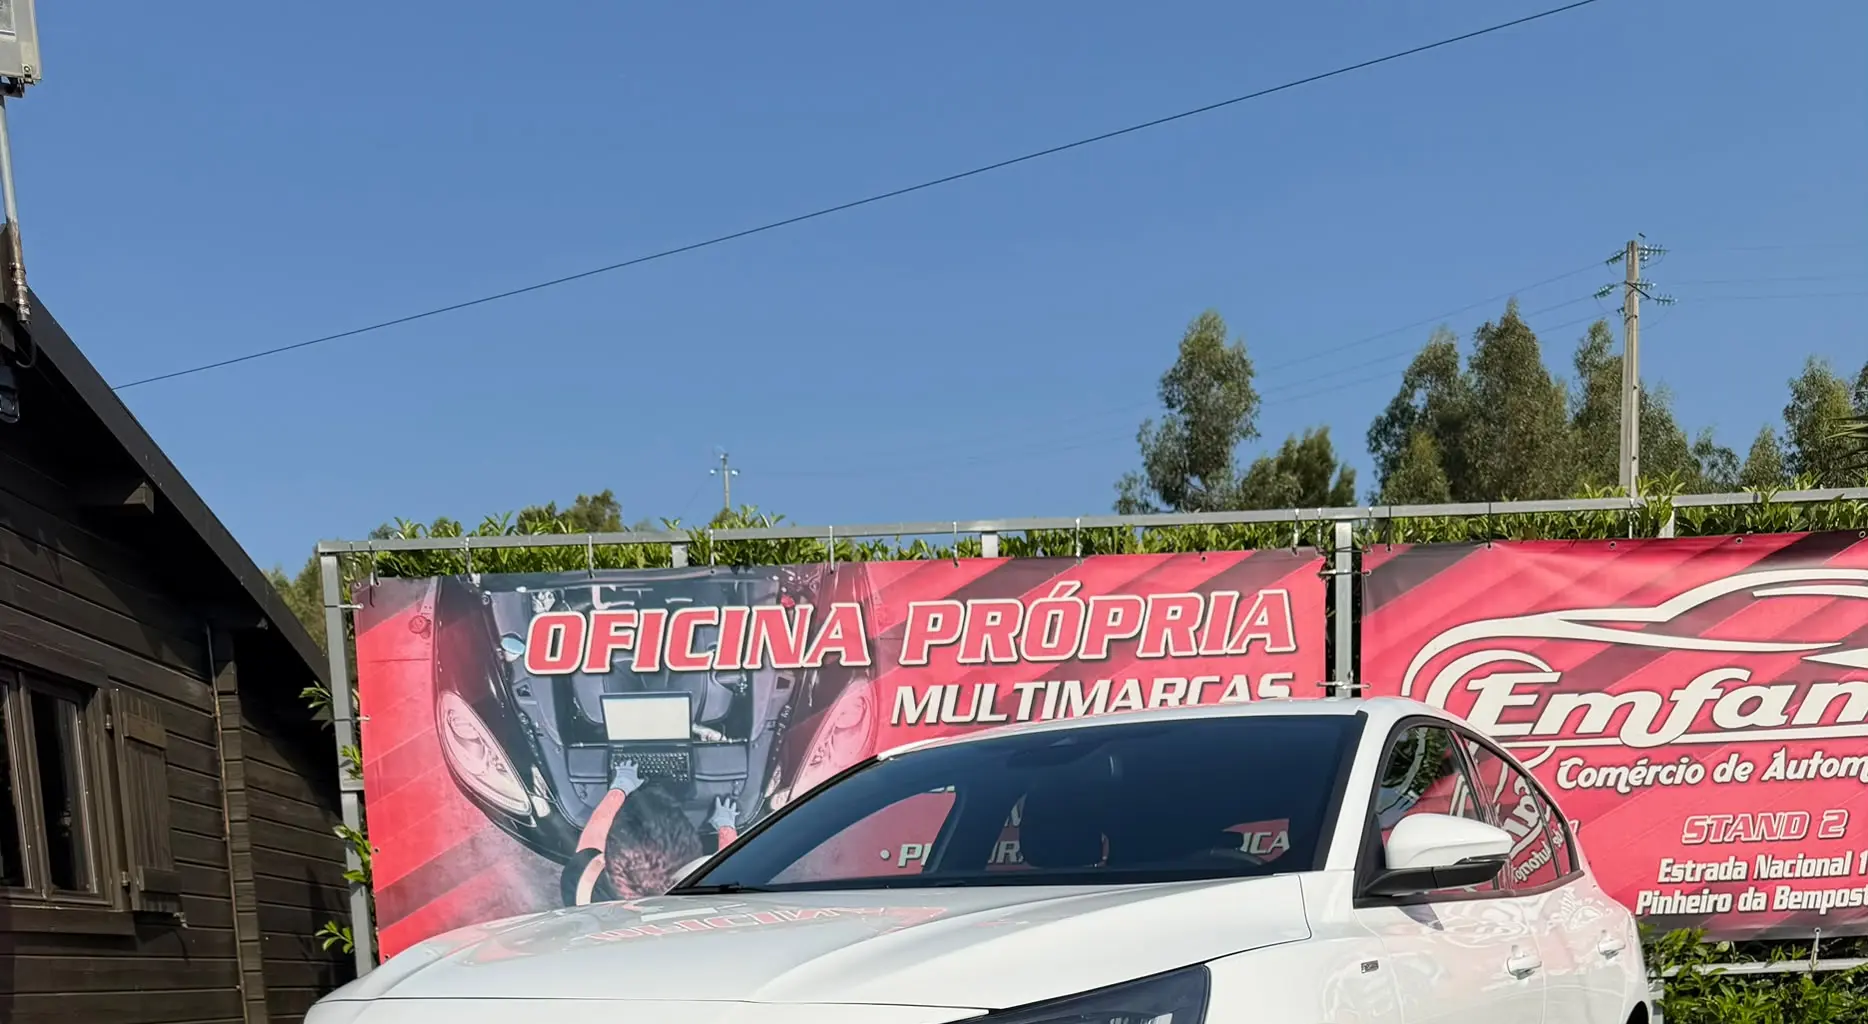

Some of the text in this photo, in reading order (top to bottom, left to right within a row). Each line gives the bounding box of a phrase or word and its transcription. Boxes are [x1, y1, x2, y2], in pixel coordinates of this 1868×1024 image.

[525, 581, 1297, 675] OFICINA PRÓPRIA
[891, 672, 1295, 725] MULTIMARCAS
[1556, 756, 1706, 794] Comércio
[1712, 753, 1754, 784] de
[1681, 809, 1848, 845] STAND 2
[1657, 855, 1748, 883] Estrada
[1753, 850, 1853, 881] Nacional
[1635, 888, 1733, 915] Pinheiro
[1737, 886, 1767, 912] da
